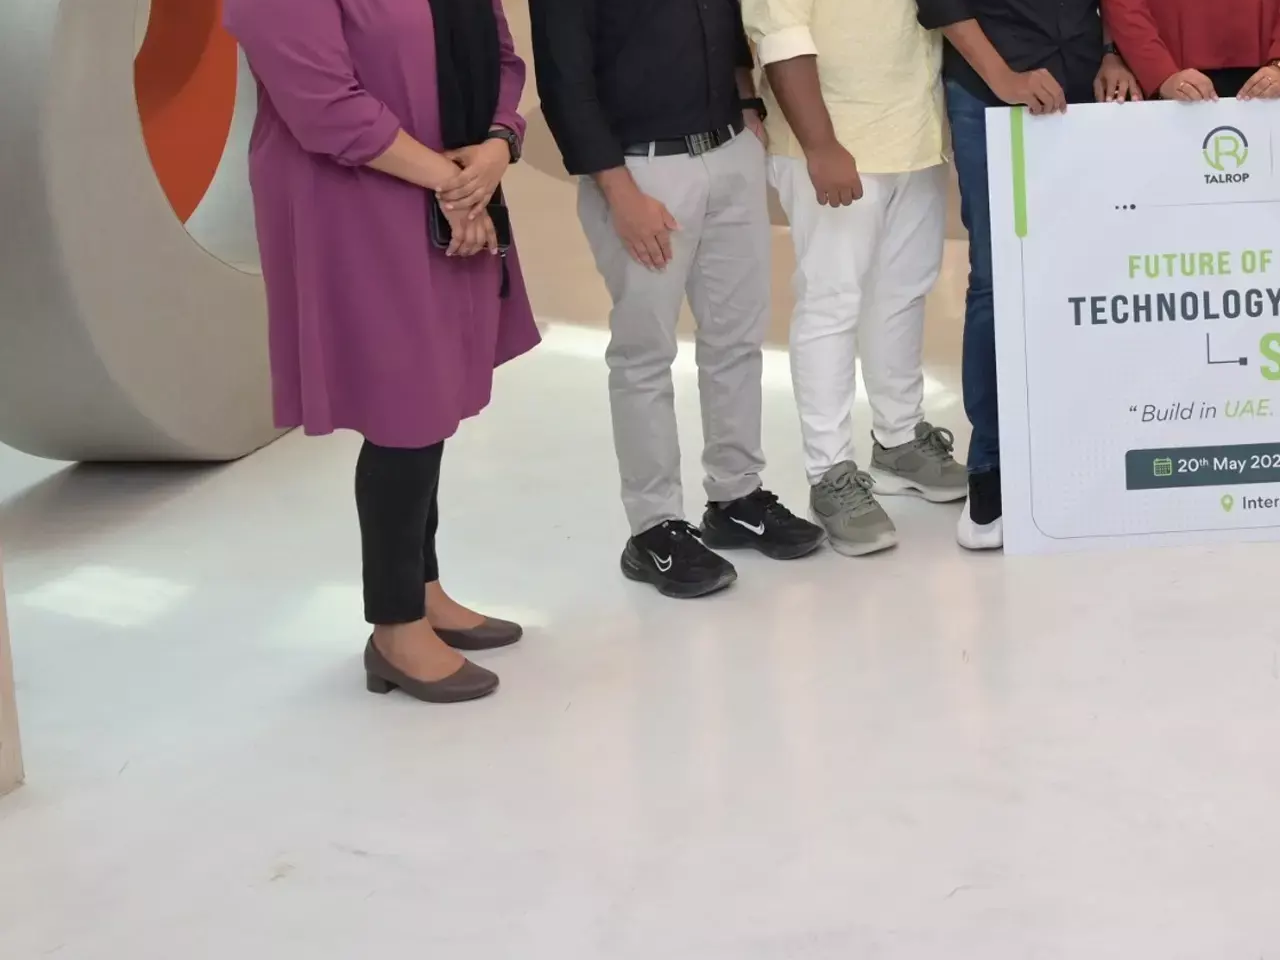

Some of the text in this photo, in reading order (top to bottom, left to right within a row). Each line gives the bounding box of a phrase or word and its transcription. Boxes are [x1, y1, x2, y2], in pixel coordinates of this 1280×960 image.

[1204, 172, 1250, 185] TALROP
[1128, 250, 1232, 279] FUTURE
[1241, 249, 1274, 274] OF
[1199, 401, 1217, 419] in
[1224, 398, 1274, 418] UAE.
[1213, 456, 1247, 474] May
